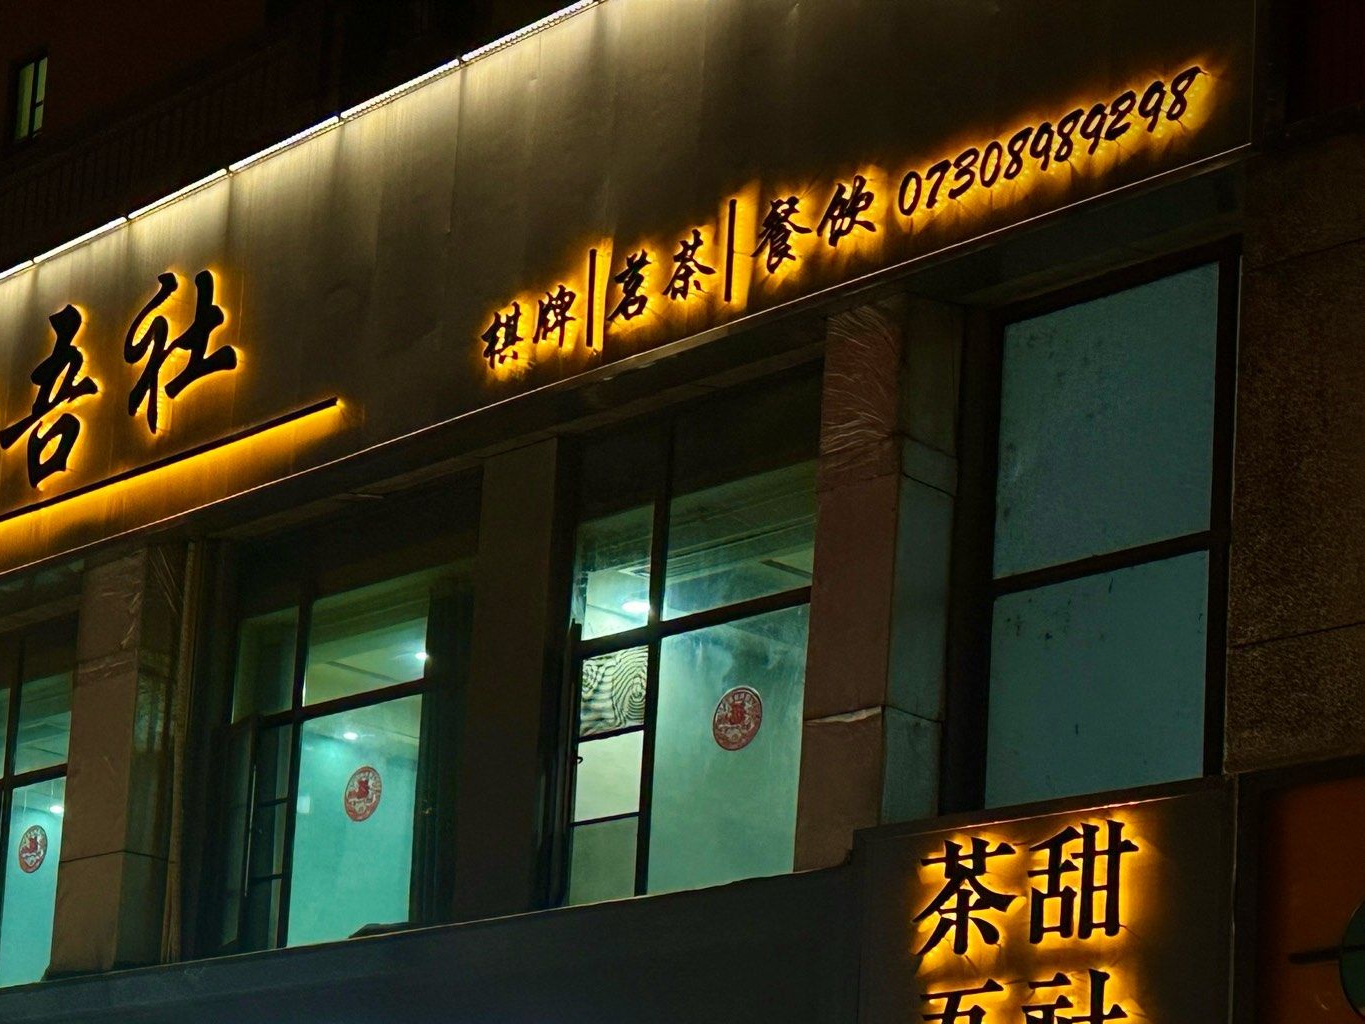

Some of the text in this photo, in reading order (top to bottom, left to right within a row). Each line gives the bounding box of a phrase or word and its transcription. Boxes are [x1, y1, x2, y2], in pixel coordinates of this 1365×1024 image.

[482, 65, 1205, 369] 棋牌 茗茶 餐饮 07308989298
[913, 819, 1139, 956] 茶甜
